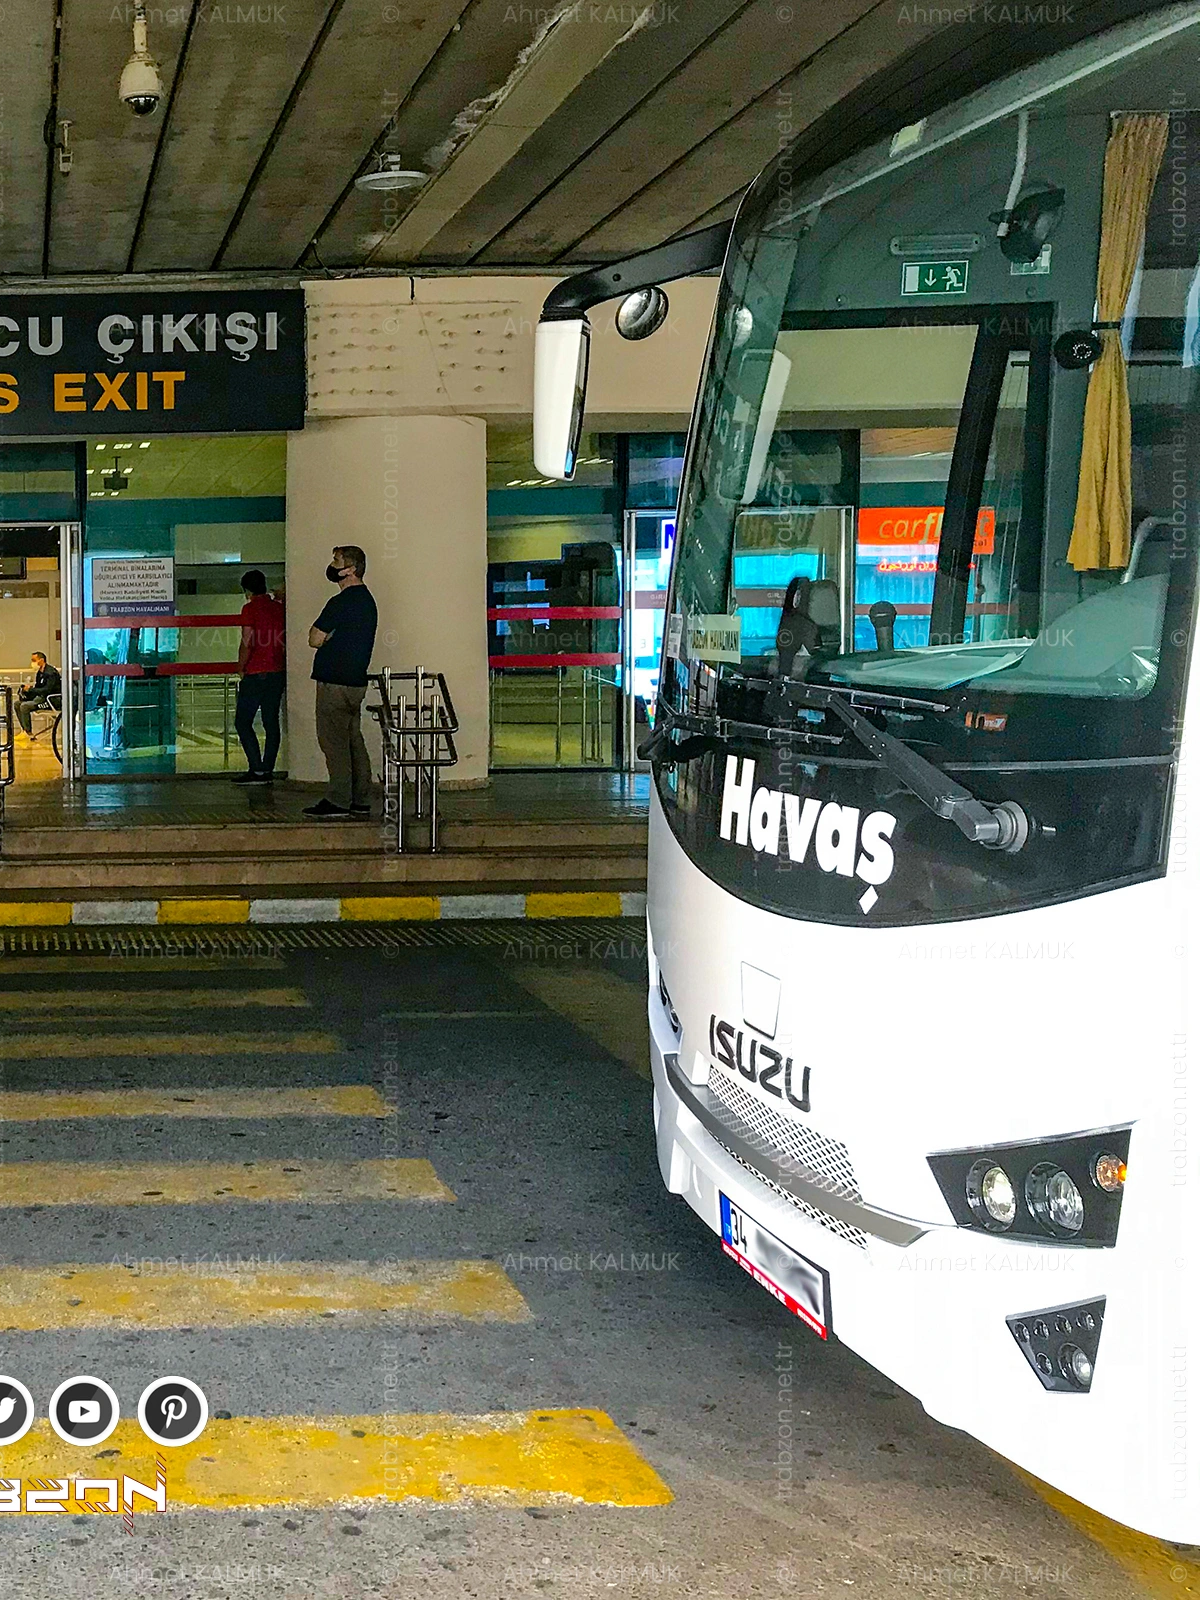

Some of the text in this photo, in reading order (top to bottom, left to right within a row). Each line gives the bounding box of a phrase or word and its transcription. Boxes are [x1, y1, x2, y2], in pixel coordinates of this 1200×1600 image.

[98, 311, 279, 363] ÇIKIŞI
[53, 370, 186, 412] EXIT
[718, 752, 898, 915] Havaş
[710, 1014, 812, 1113] ISUZU
[730, 1207, 748, 1254] 34
